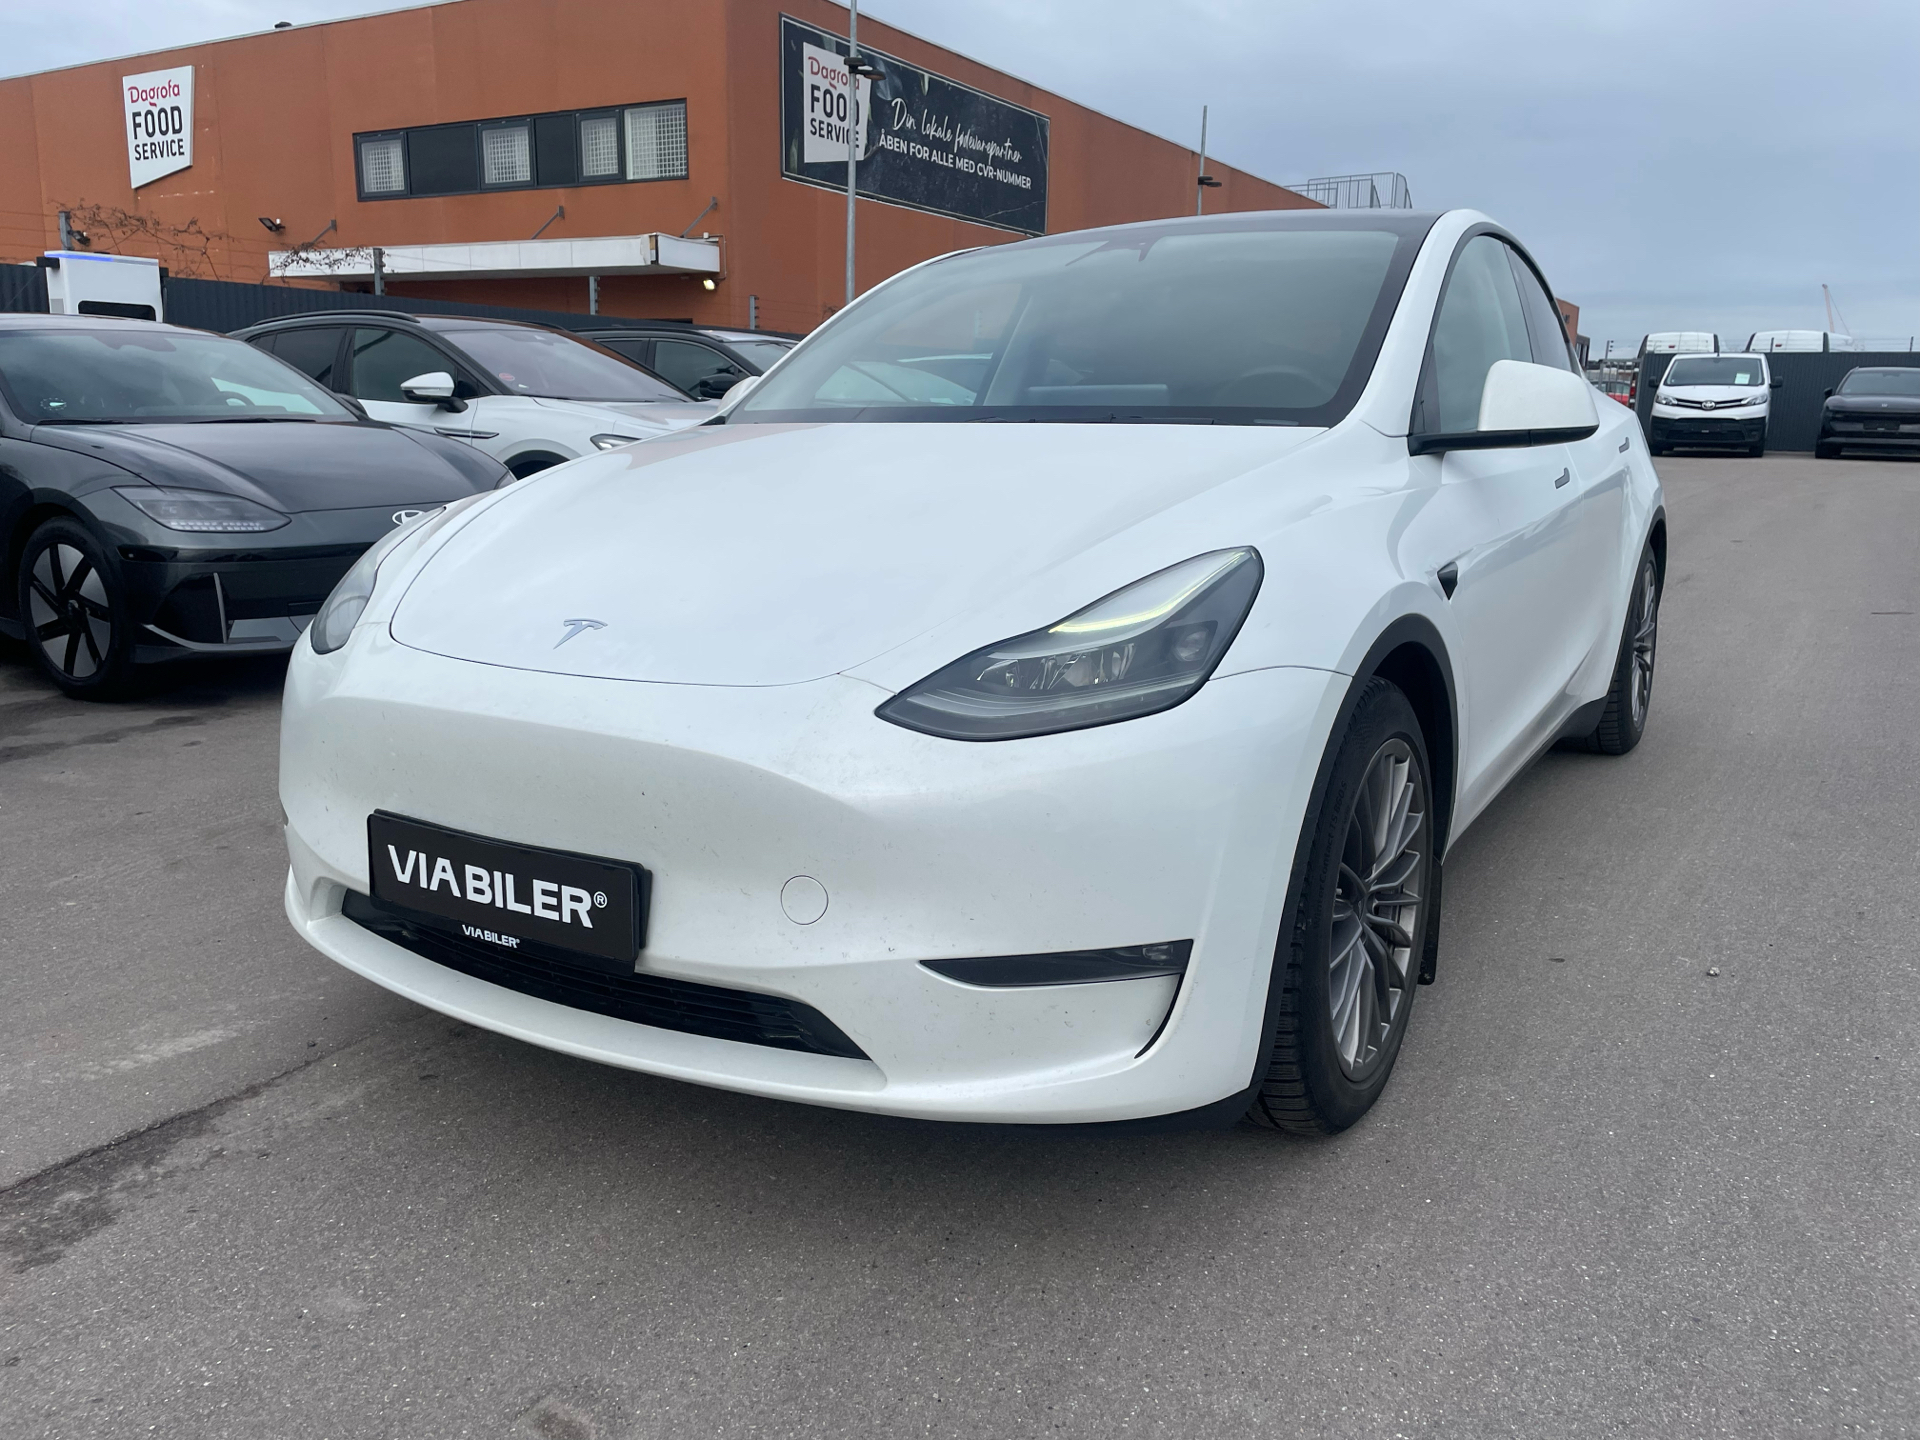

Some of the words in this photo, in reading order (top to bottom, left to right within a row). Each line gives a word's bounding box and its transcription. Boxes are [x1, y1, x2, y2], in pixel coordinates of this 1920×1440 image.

[128, 79, 181, 107] Dagrofa
[132, 105, 183, 140] FOOD
[891, 98, 917, 130] Din
[921, 108, 953, 141] lokale
[134, 138, 185, 161] SERVICE
[879, 128, 908, 154] ÅBEN
[909, 142, 930, 161] FOR
[930, 149, 954, 168] ALLE
[955, 156, 976, 173] MED
[976, 163, 1032, 190] CVR-NUMMER
